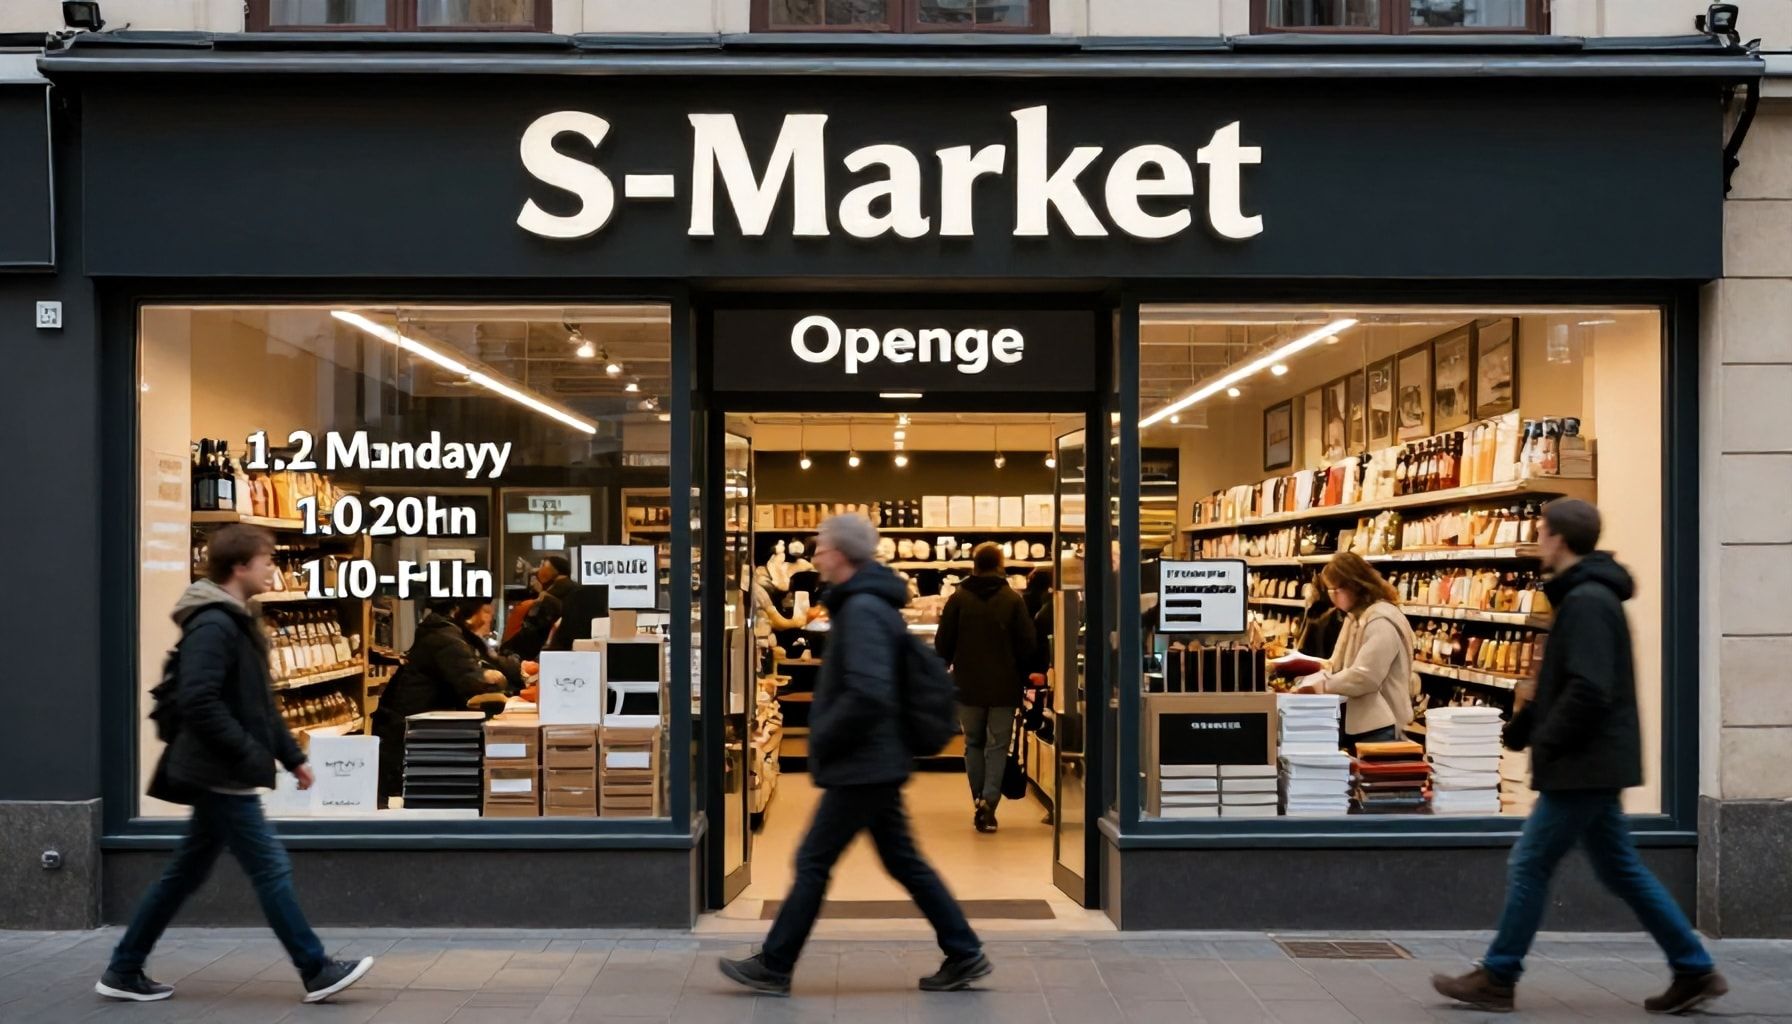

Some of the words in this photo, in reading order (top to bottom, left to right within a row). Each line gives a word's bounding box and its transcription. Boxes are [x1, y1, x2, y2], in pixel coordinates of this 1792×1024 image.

[516, 105, 1264, 240] S-Market
[791, 315, 1025, 375] Openge
[247, 430, 317, 471] 1.2
